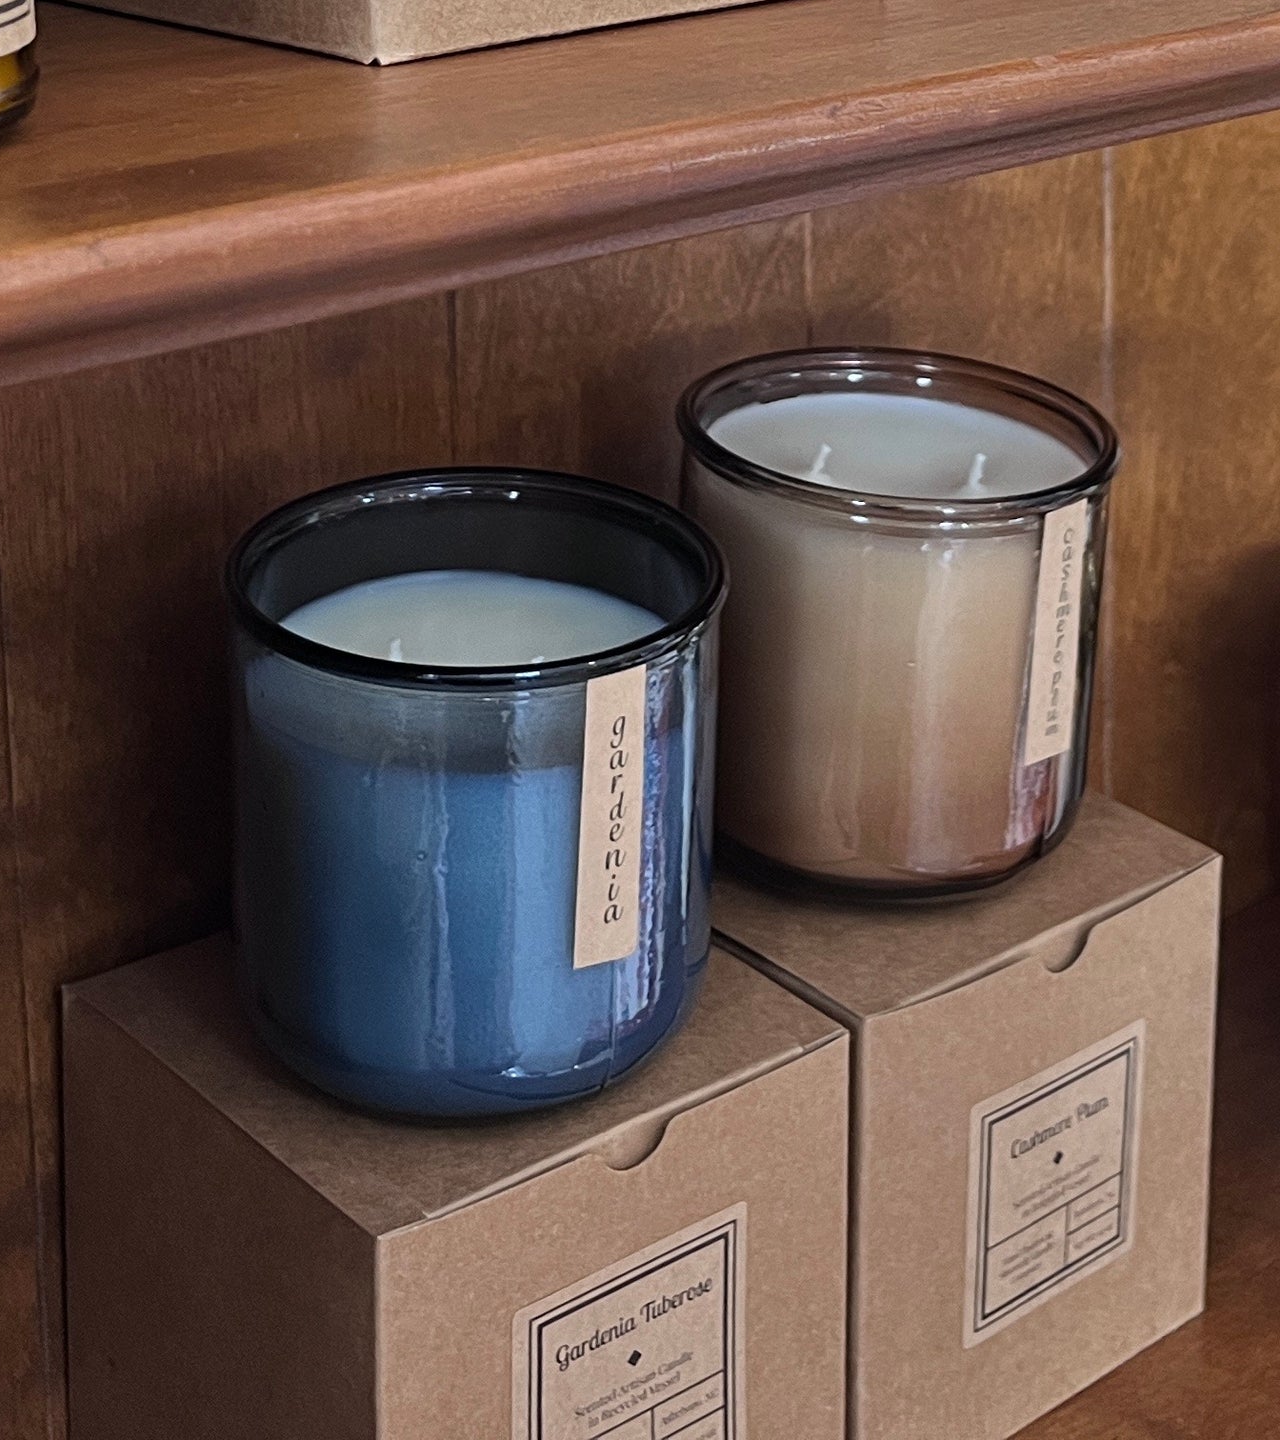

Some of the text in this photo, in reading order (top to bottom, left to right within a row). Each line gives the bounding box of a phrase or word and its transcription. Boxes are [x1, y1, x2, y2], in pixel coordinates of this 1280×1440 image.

[604, 715, 629, 924] gardenia
[1010, 1115, 1073, 1159] Cashmere
[555, 1278, 713, 1372] Gardenia Tuberose
